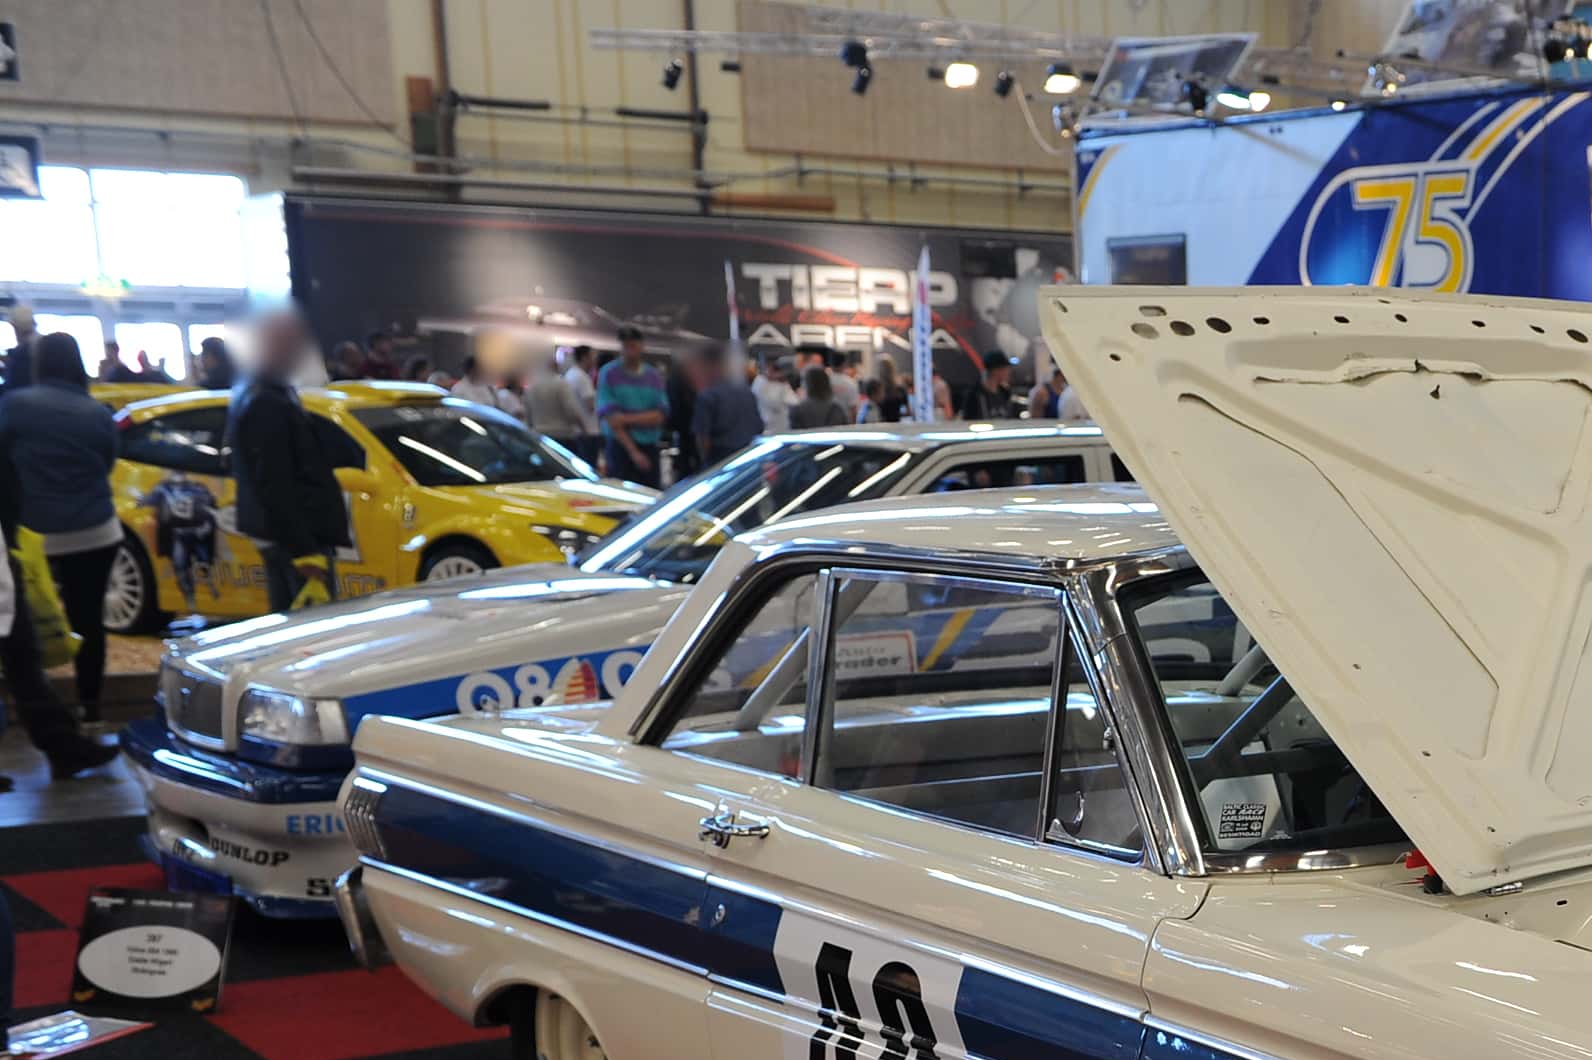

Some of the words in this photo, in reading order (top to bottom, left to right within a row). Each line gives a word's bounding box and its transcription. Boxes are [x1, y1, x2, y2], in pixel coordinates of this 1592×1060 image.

[1352, 168, 1473, 294] 75
[741, 262, 959, 315] TIERP
[748, 322, 959, 351] ARENA
[211, 836, 290, 867] DUNLOP
